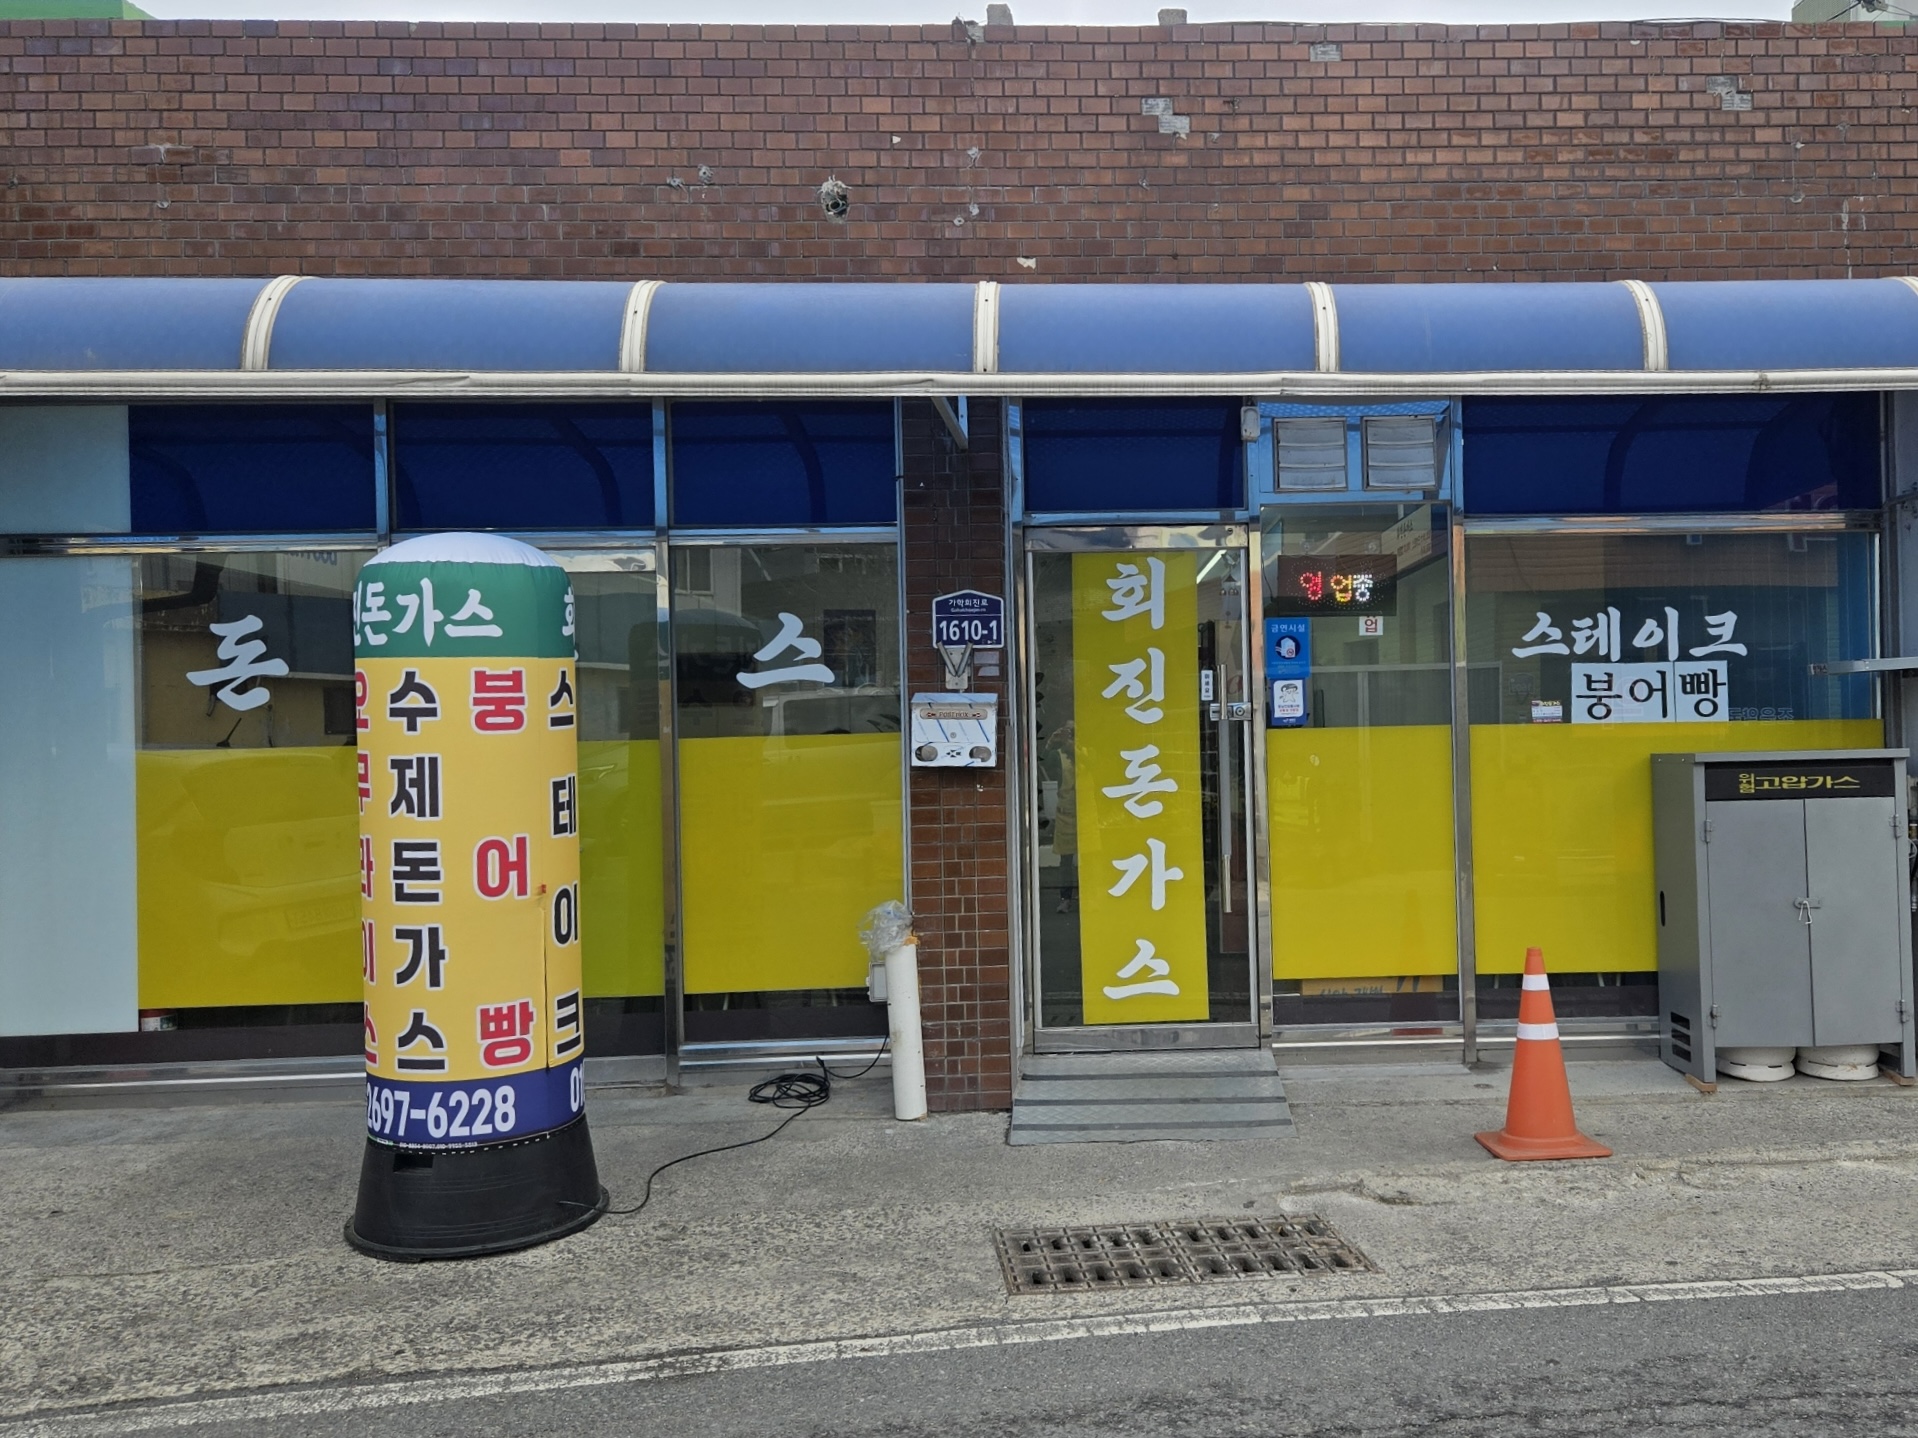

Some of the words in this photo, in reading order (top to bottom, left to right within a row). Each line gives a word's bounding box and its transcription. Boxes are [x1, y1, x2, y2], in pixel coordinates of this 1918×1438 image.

[939, 619, 997, 641] 1610-1
[1271, 623, 1306, 633] 금연시설
[1364, 615, 1378, 633] 업
[1511, 606, 1748, 662] 스테이크
[185, 614, 290, 712] 돈
[736, 612, 835, 688] 스
[1575, 668, 1727, 720] 붕어빵
[1101, 556, 1184, 1000] 회진돈가스
[1755, 775, 1861, 790] 고압가스
[388, 670, 447, 1070] 수제돈가스
[471, 669, 534, 1067] 붕어빵
[550, 669, 582, 1055] 스테이크
